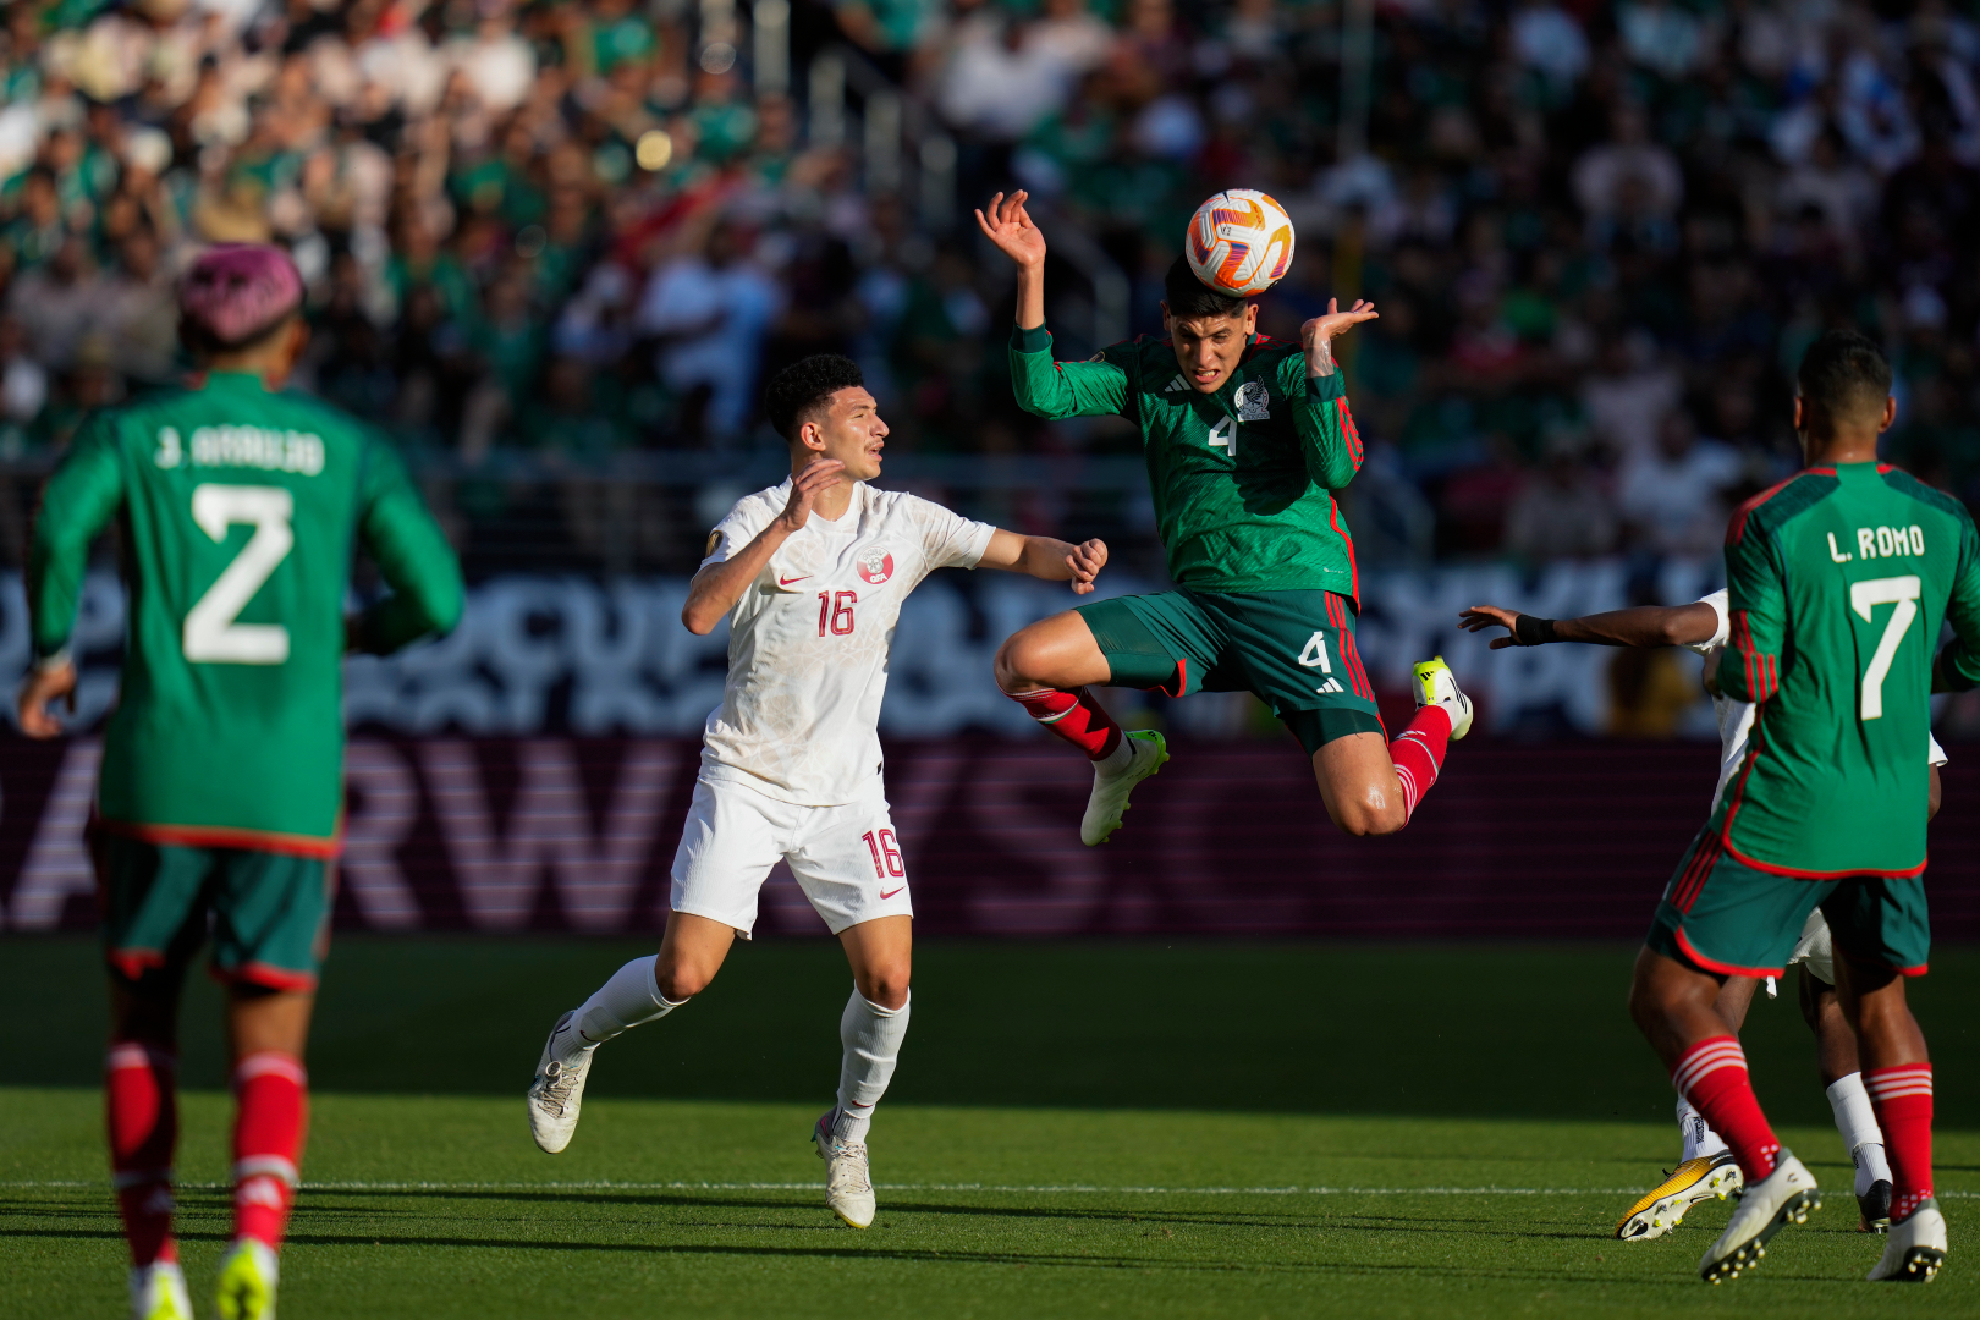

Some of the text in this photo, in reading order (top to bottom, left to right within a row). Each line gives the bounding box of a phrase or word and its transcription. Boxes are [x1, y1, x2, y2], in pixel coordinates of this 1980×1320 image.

[1208, 414, 1237, 456] 4
[1827, 525, 1926, 563] L. ROMO
[182, 483, 294, 665] 2
[818, 589, 858, 638] 16
[1298, 631, 1331, 673] 4
[1851, 574, 1921, 721] 7
[862, 829, 904, 878] 16
